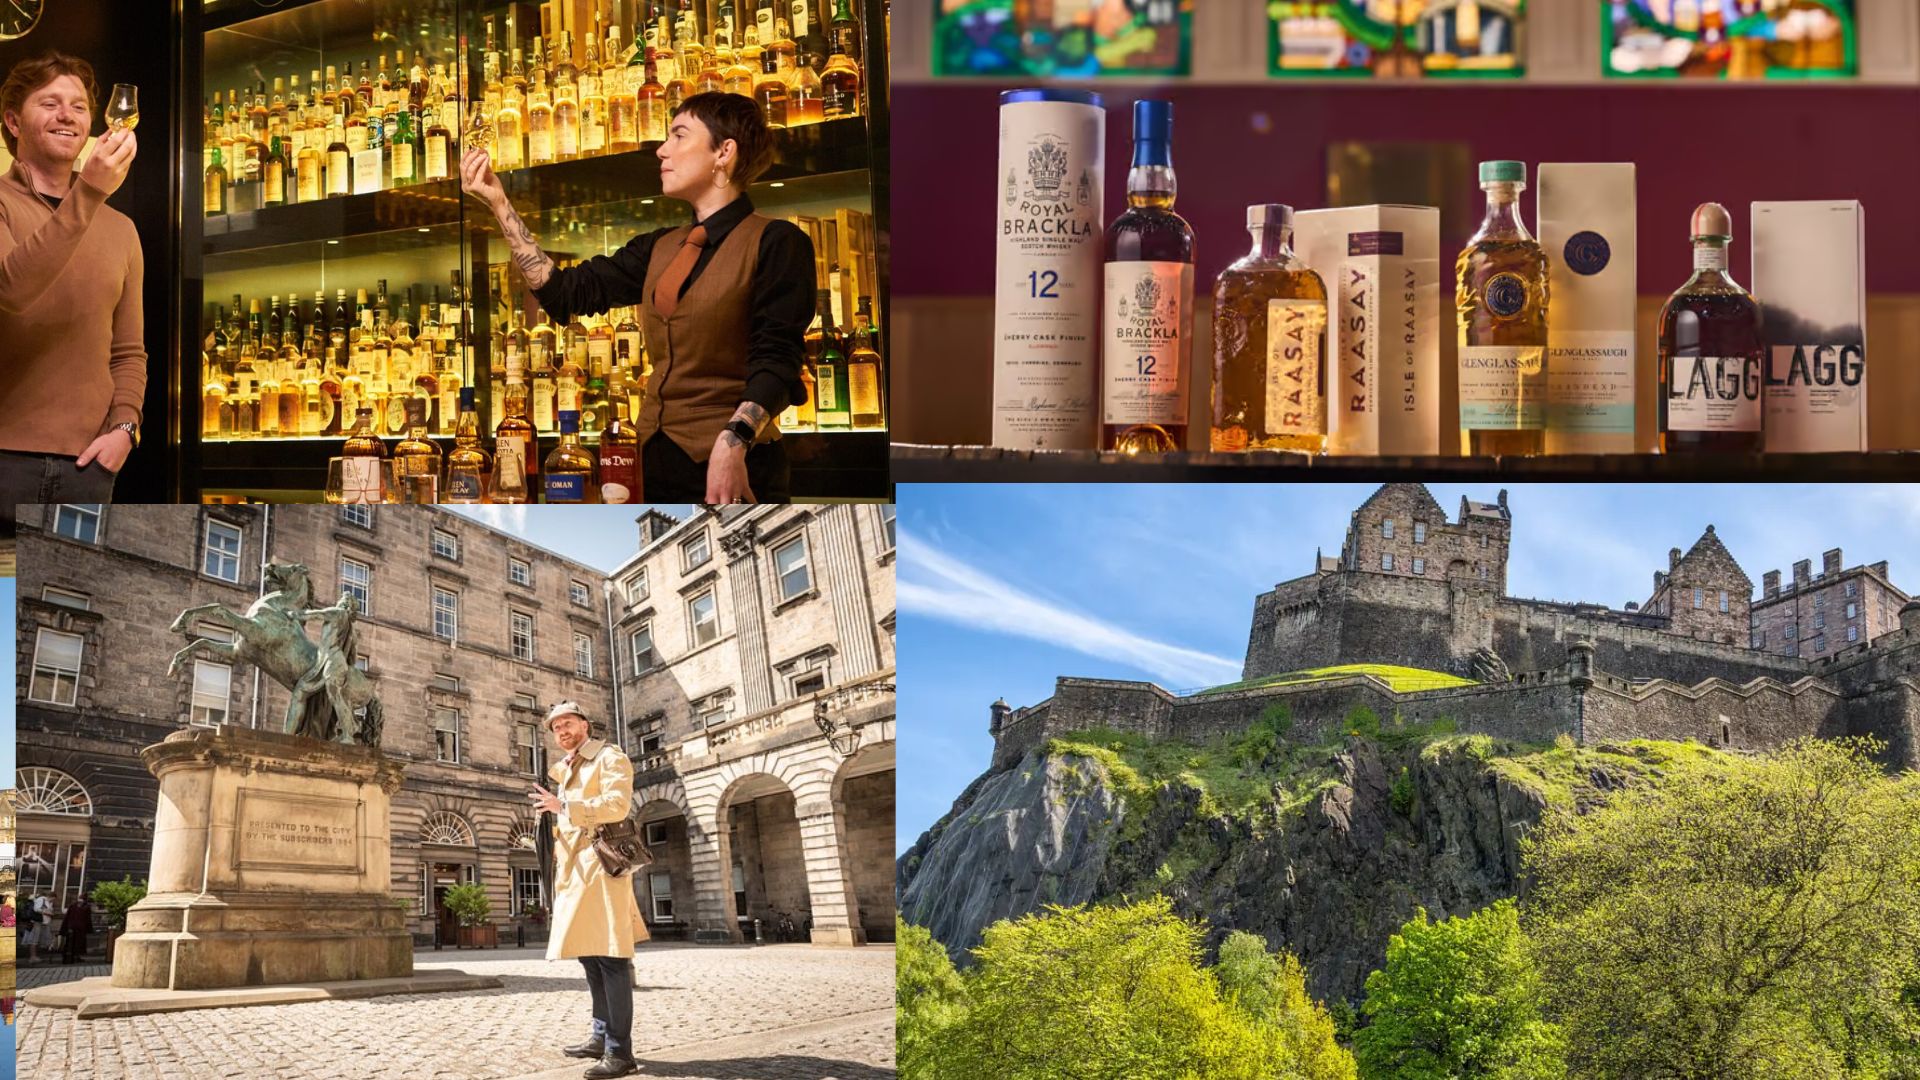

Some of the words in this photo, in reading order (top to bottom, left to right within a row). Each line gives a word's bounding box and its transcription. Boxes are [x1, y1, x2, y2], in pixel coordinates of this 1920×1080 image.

[1020, 201, 1074, 217] ROYAL
[1004, 218, 1092, 236] BRACKLA
[1028, 270, 1059, 298] 12
[1404, 268, 1415, 343] RAASAY
[1130, 316, 1165, 327] ROYAL
[1117, 327, 1178, 339] BRACKLA
[1350, 270, 1366, 412] RAASAY
[1136, 355, 1157, 375] 12
[1283, 307, 1304, 426] RAASAY
[1406, 350, 1413, 365] OF
[1764, 345, 1864, 387] LAGG
[1668, 356, 1760, 401] LAGG
[1404, 372, 1415, 411] ISLE
[612, 455, 634, 467] Dew
[249, 820, 297, 831] PRESENTED
[300, 824, 310, 833] TO
[314, 825, 329, 834] THE
[246, 831, 258, 840] BY
[262, 832, 277, 840] THE
[280, 834, 333, 844] SUBSCRIBERS
